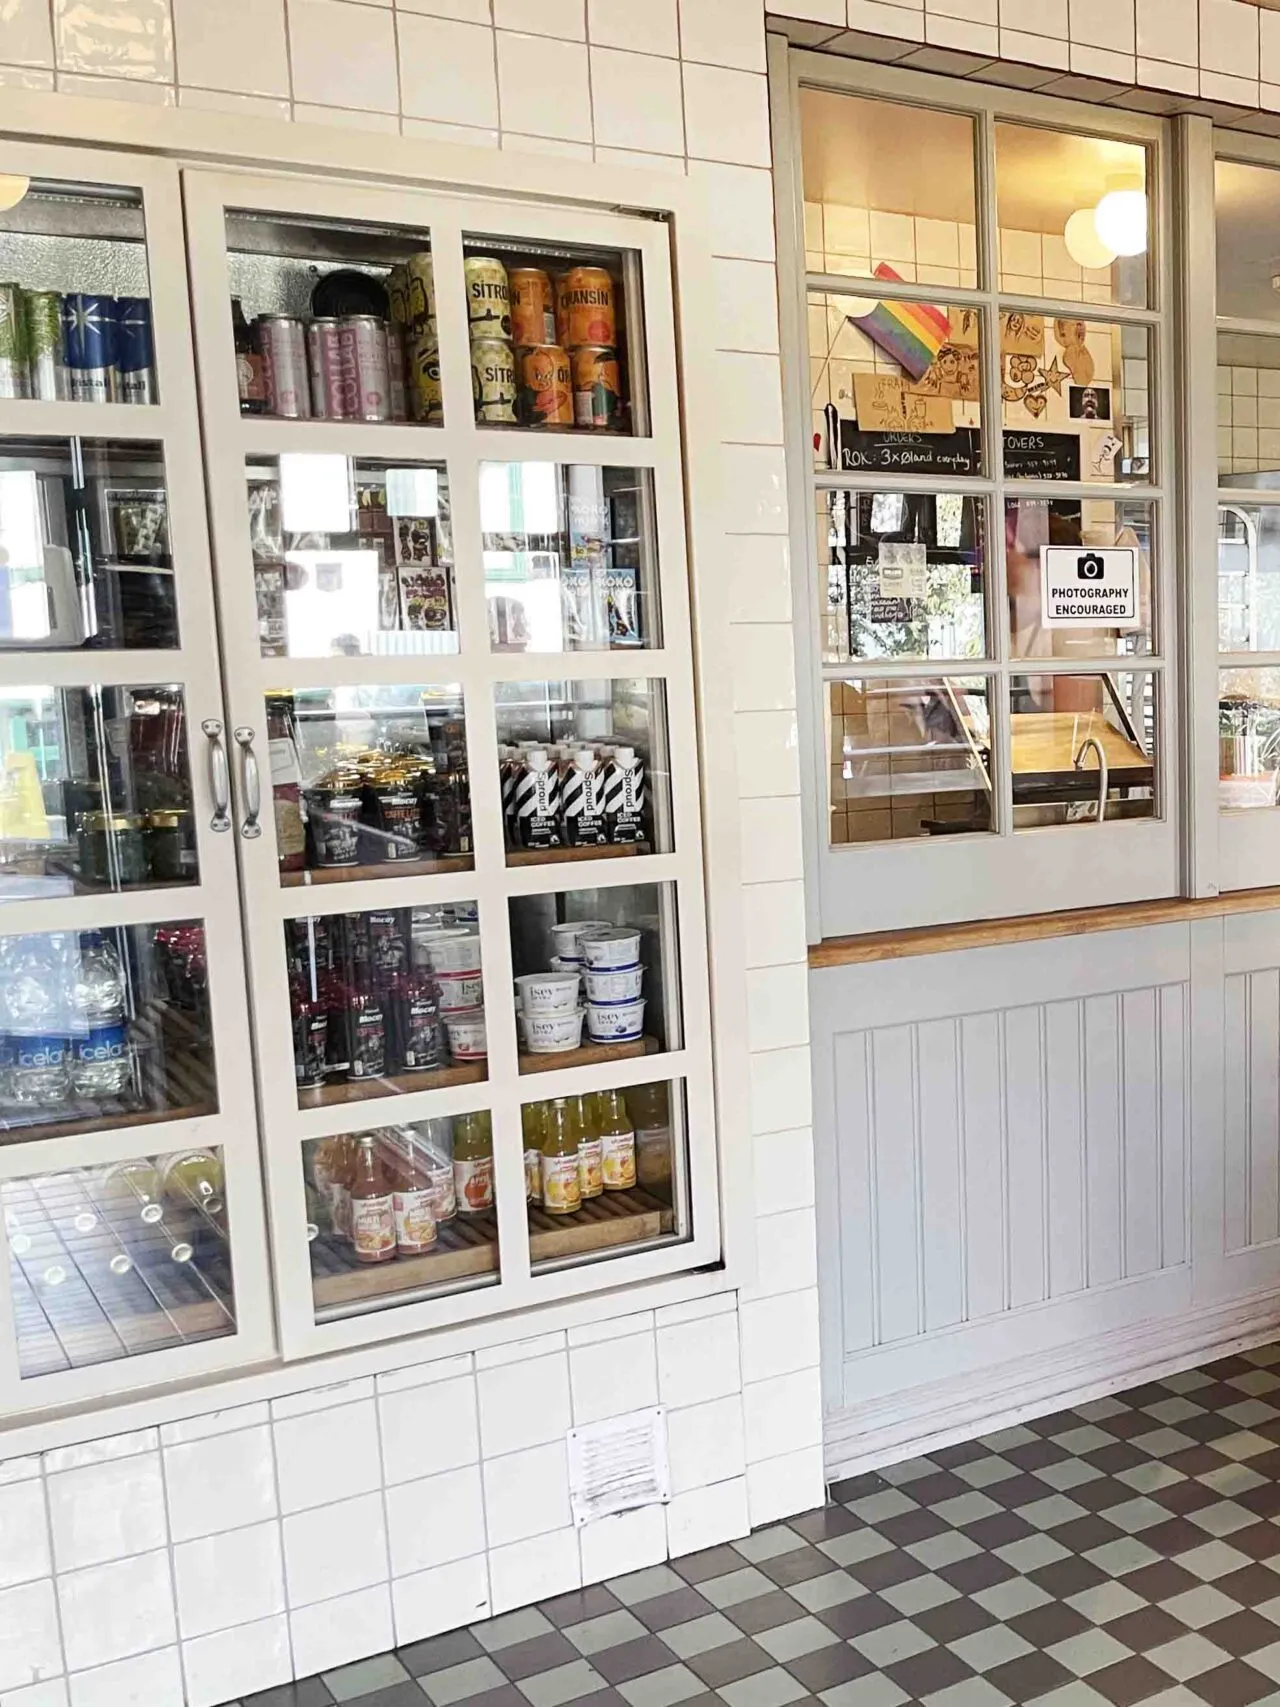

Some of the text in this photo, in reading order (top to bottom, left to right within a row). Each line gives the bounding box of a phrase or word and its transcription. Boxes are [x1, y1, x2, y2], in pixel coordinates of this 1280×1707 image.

[1052, 588, 1129, 599] PHOTOGRAPHY
[1056, 604, 1127, 615] ENCOURAGED
[536, 771, 548, 812] Sproud
[584, 771, 595, 811] Sproud
[624, 768, 634, 808] Sproud
